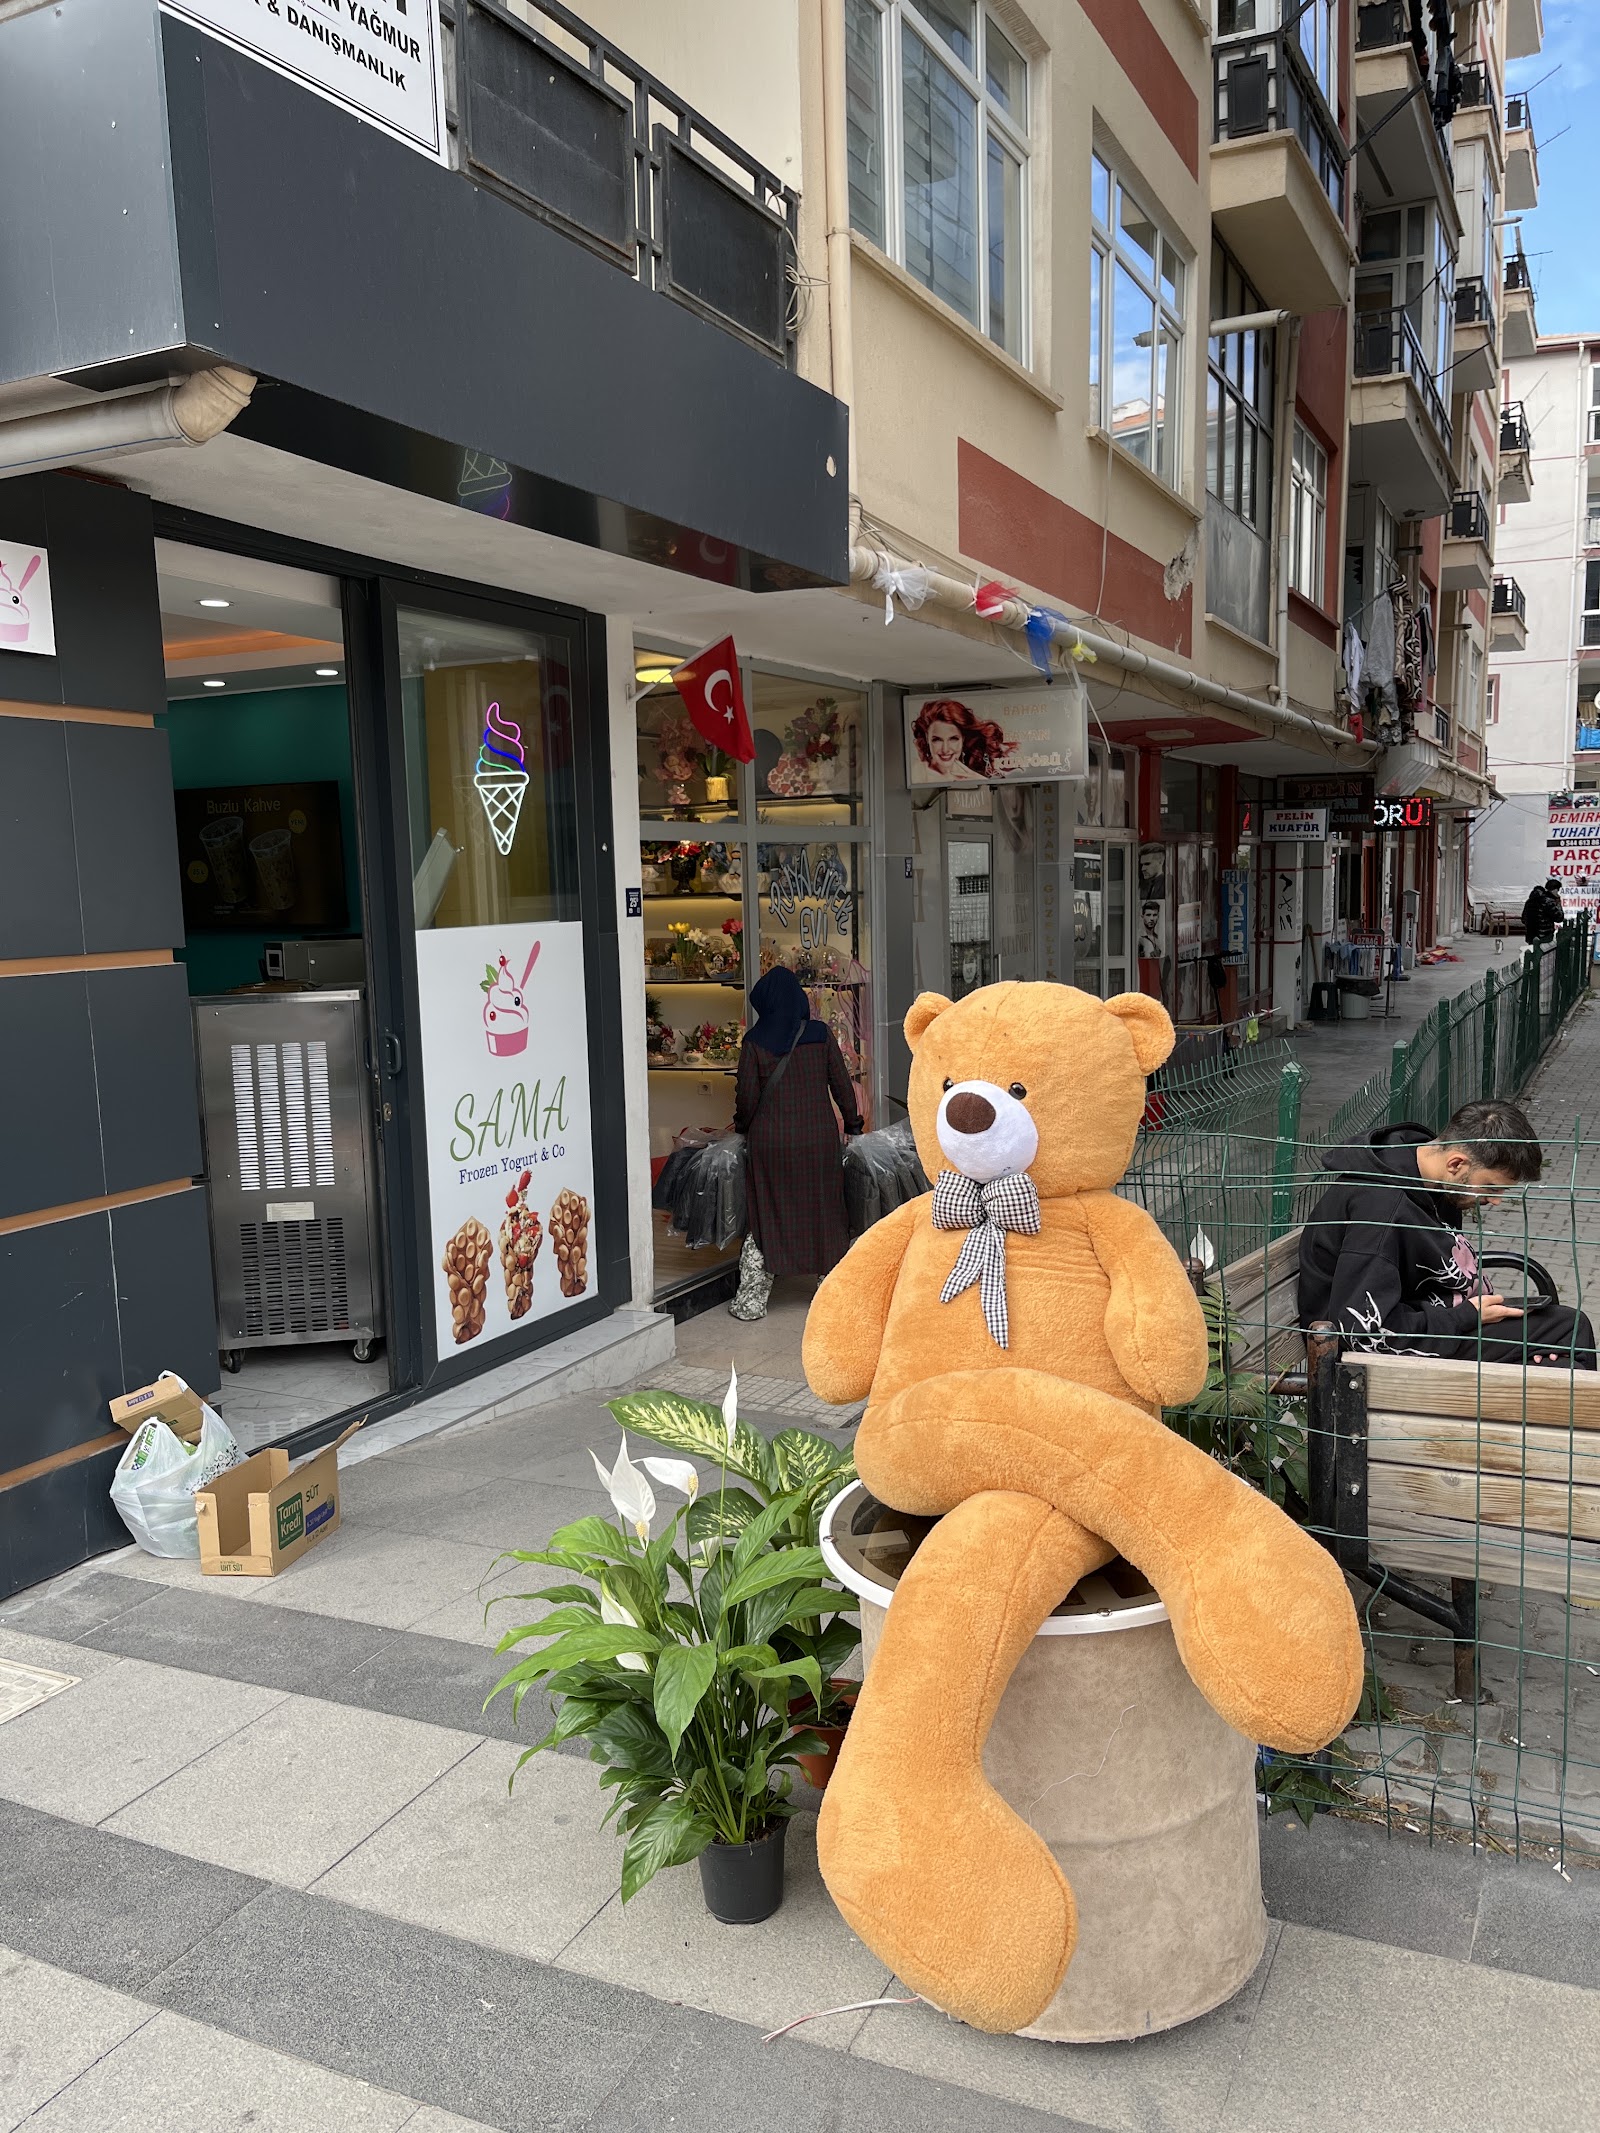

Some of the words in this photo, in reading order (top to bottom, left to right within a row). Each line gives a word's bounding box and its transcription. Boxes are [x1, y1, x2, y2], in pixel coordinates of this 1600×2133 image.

[347, 0, 422, 63] YAĞMUR
[287, 5, 407, 92] DANIŞMANLIK
[1003, 703, 1048, 716] BAHAR
[994, 752, 1062, 769] KUAFÖRÜ
[207, 799, 239, 814] Buzlu
[244, 797, 281, 813] Kahve
[1276, 811, 1314, 821] PELİN
[1269, 821, 1320, 832] KUAFÖR
[450, 1076, 569, 1161] SAMA
[459, 1163, 498, 1185] Frozen
[501, 1151, 538, 1173] Yogurt
[541, 1148, 549, 1161] &
[552, 1144, 565, 1158] Co
[305, 1484, 320, 1502] SÜT
[278, 1499, 302, 1521] Tarım
[280, 1512, 302, 1538] Kredi
